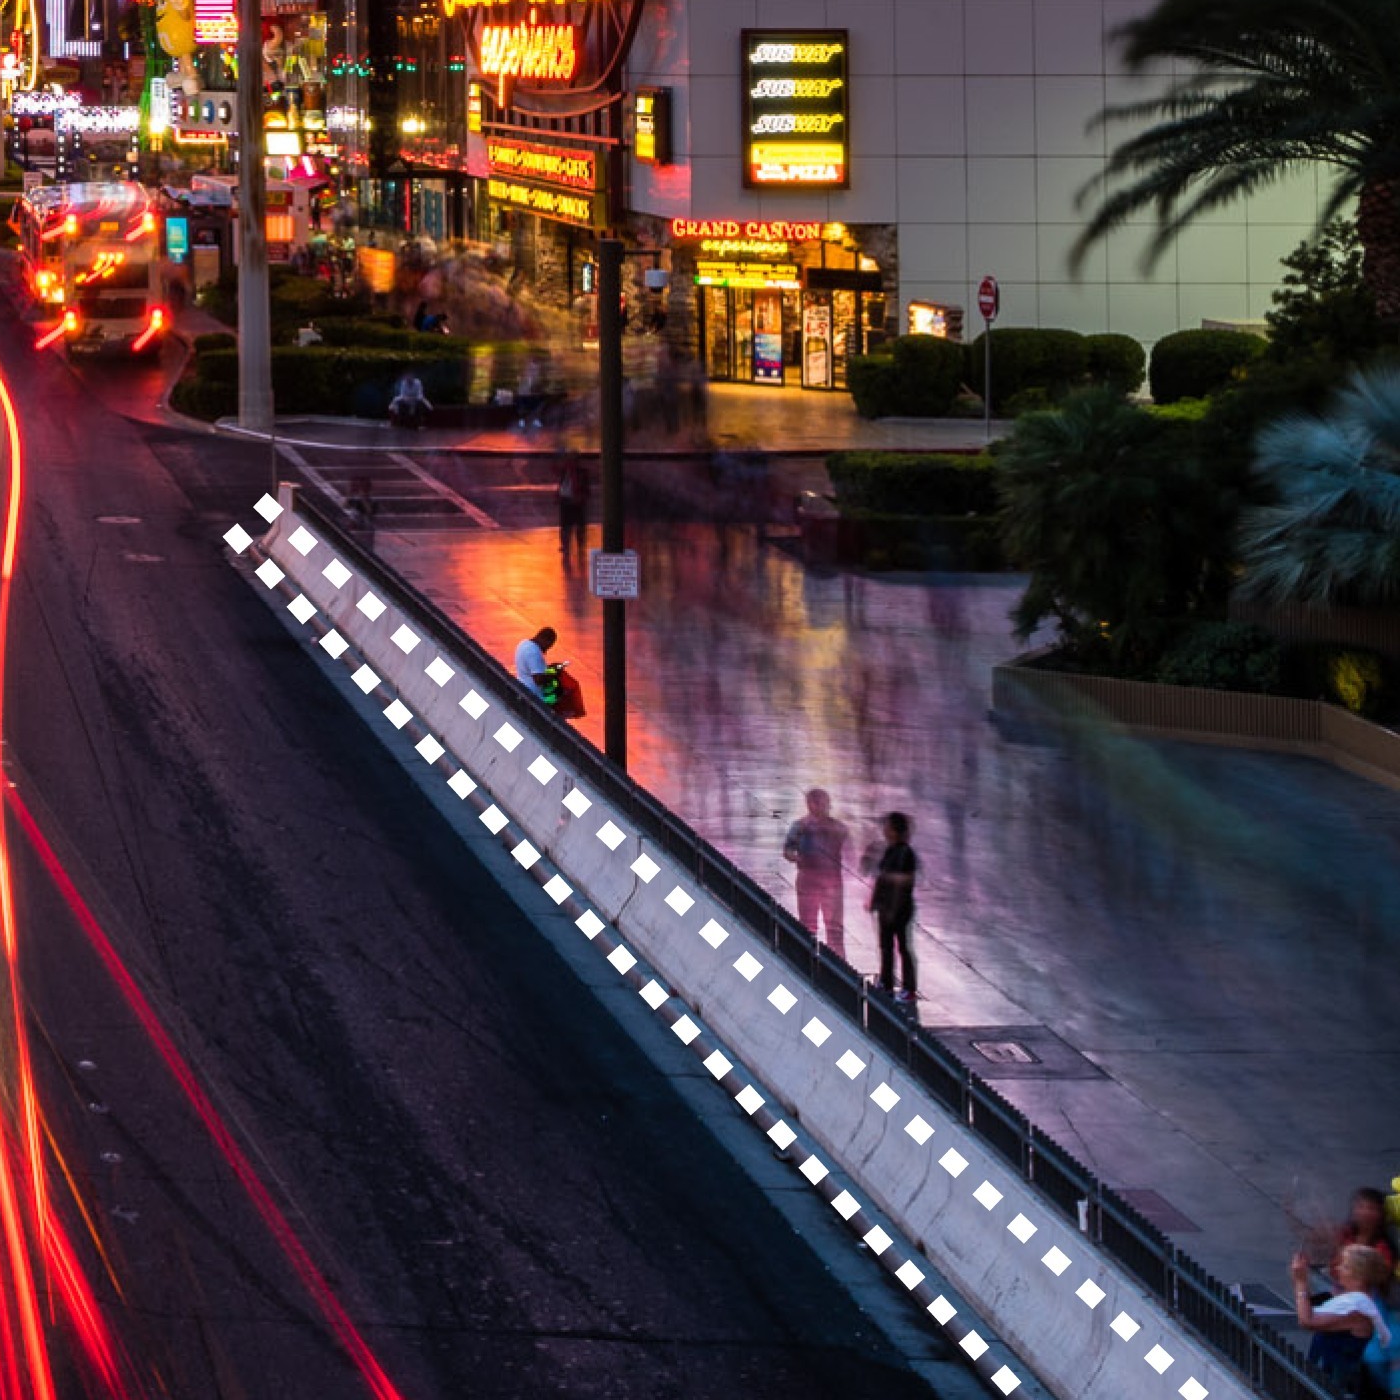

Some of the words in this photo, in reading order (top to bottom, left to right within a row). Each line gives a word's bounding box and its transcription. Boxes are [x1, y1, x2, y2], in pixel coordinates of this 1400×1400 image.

[749, 43, 843, 64] SUBWAY
[750, 78, 843, 99] SUBWAY
[750, 113, 843, 134] SUBWAY
[673, 219, 740, 238] GRAND
[745, 221, 821, 241] CANYON
